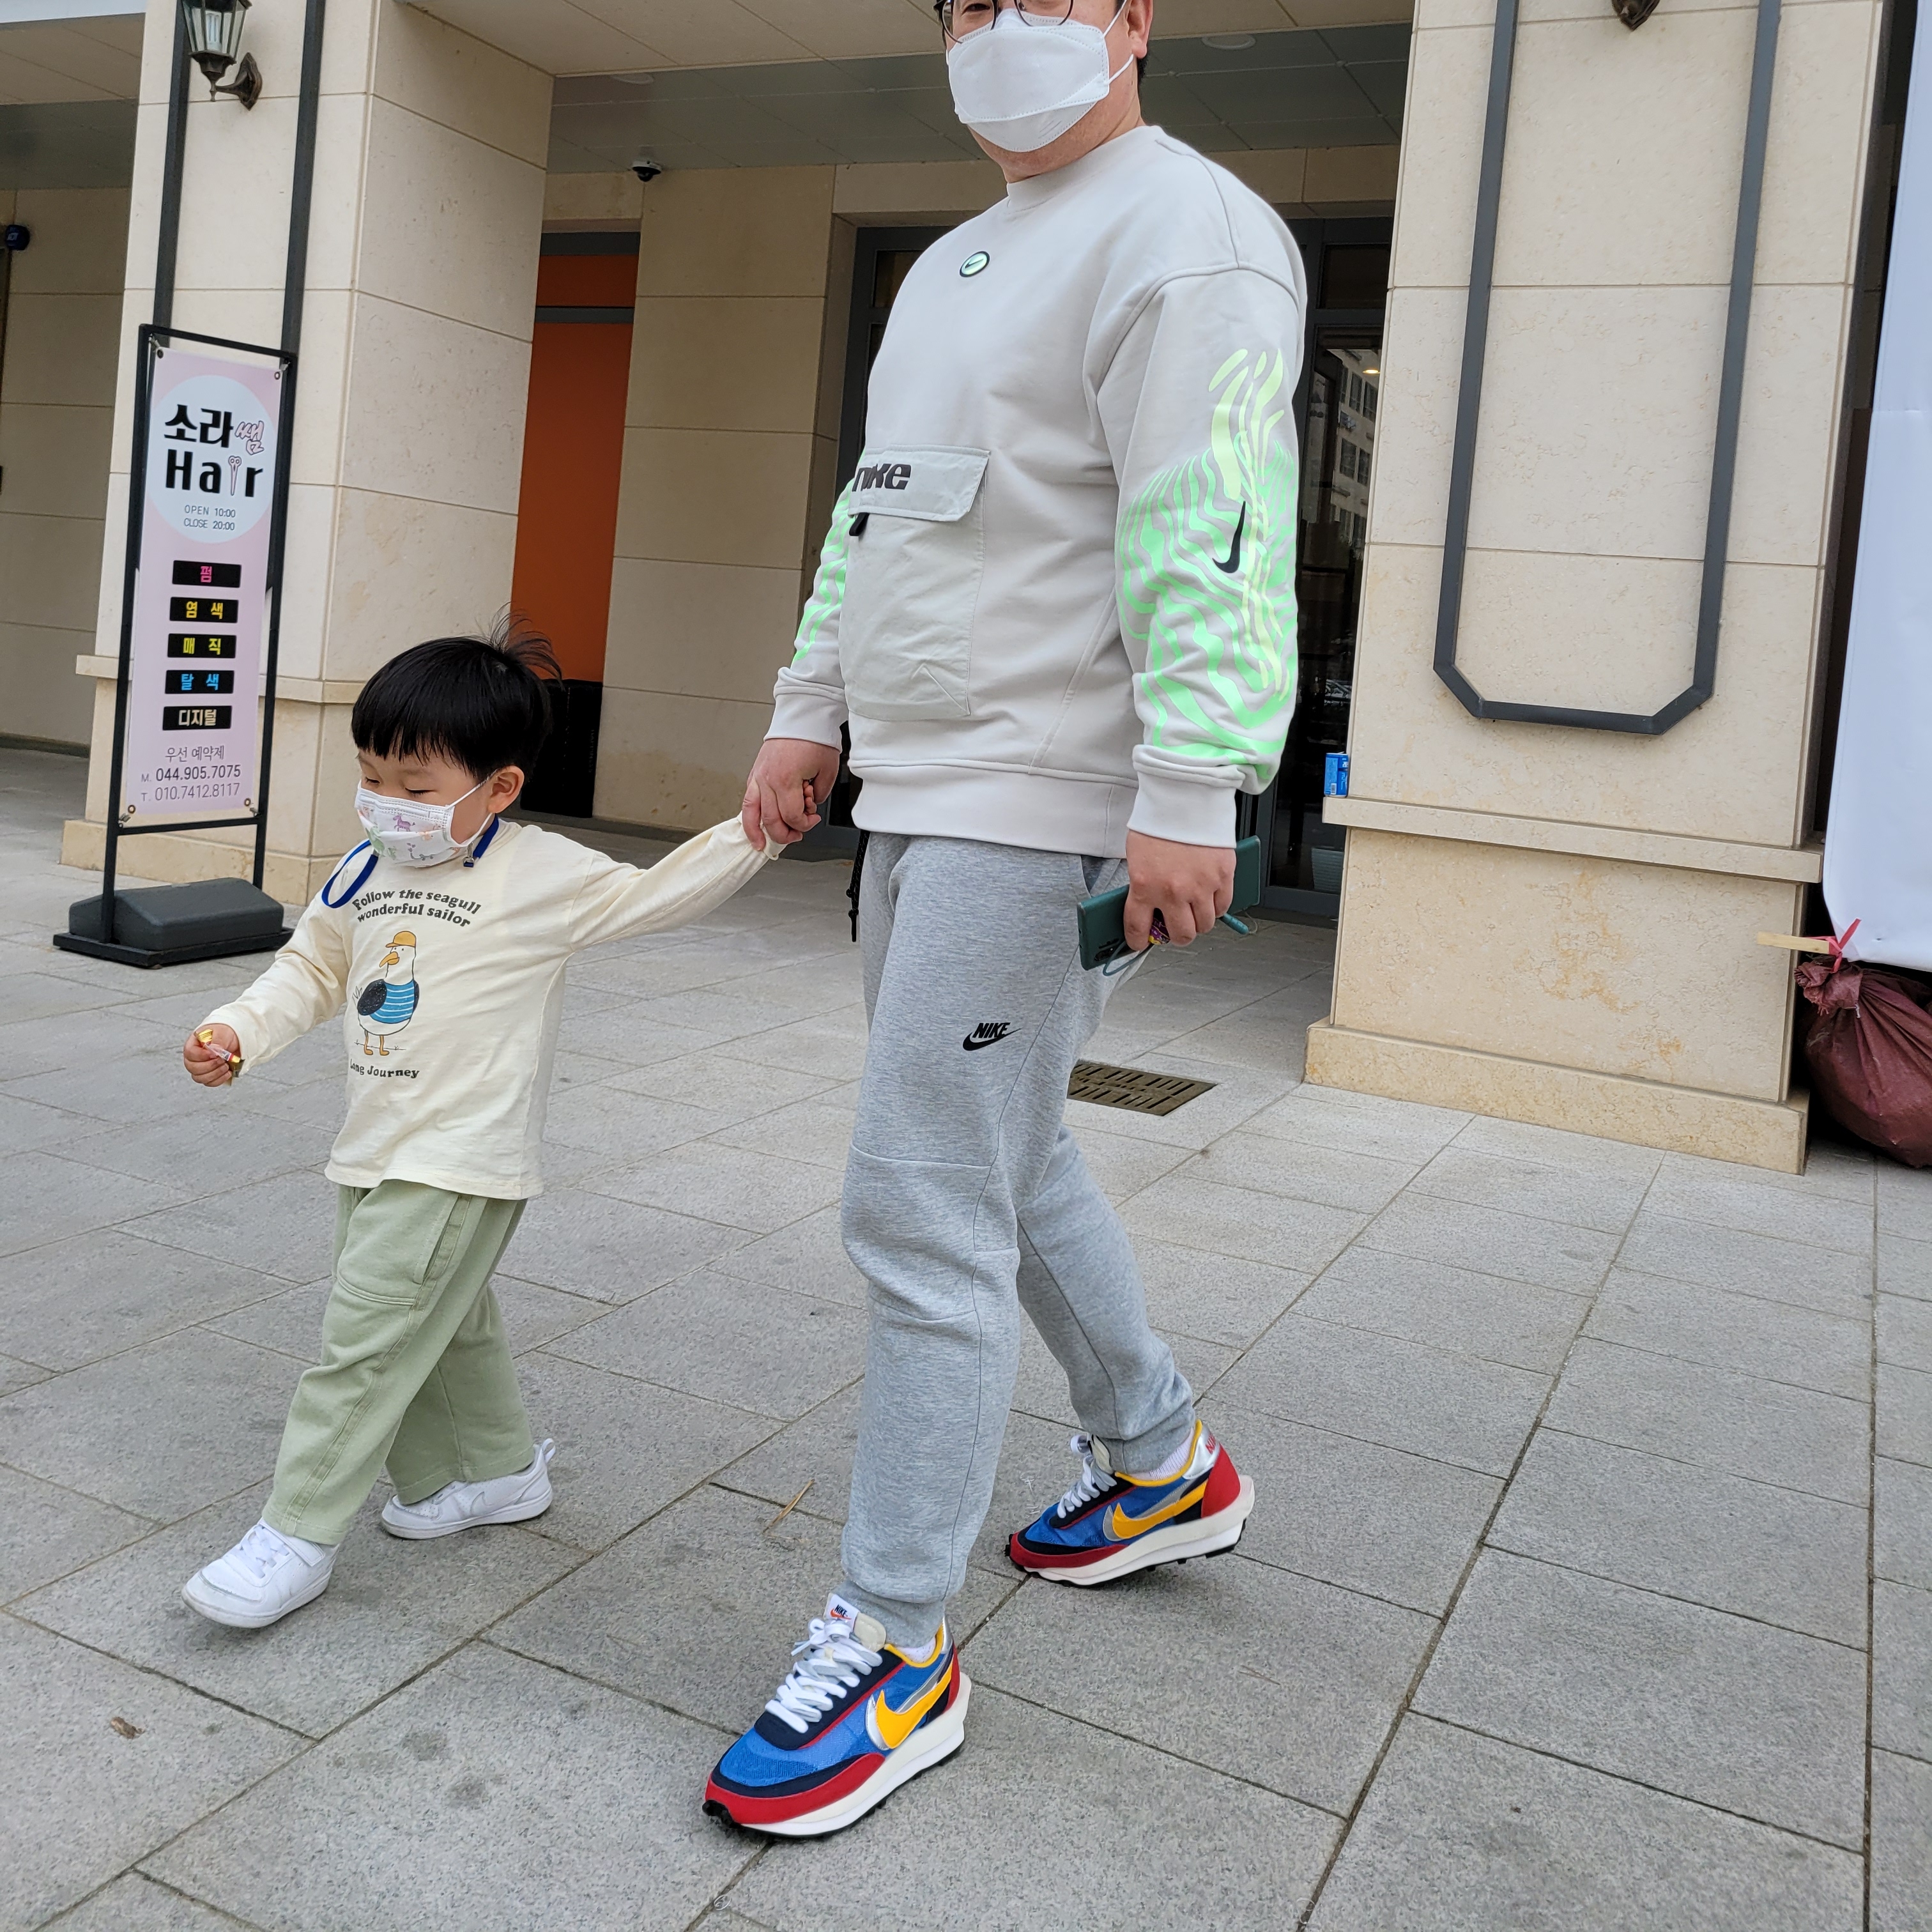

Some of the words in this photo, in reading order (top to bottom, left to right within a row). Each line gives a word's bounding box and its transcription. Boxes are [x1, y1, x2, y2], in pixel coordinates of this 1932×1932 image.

[165, 448, 263, 498] Hair
[184, 505, 210, 516] OPEN
[214, 508, 236, 518] 10:00
[184, 518, 208, 529] CLOSE
[212, 521, 235, 531] 20:00
[200, 565, 212, 583] 펌
[178, 709, 217, 726] 디지털
[165, 747, 188, 763] 우선
[191, 744, 225, 762] 예약제
[155, 764, 241, 781] 044.905.7075
[155, 783, 241, 801] 010.7412.8117
[351, 889, 395, 911] Follow
[399, 889, 423, 900] the
[425, 891, 482, 915] seagull
[357, 903, 425, 923] wonderful
[427, 907, 471, 927] sailor
[972, 1022, 1011, 1039] NIKE
[367, 1065, 420, 1078] Journey
[834, 1604, 848, 1617] NIKE
